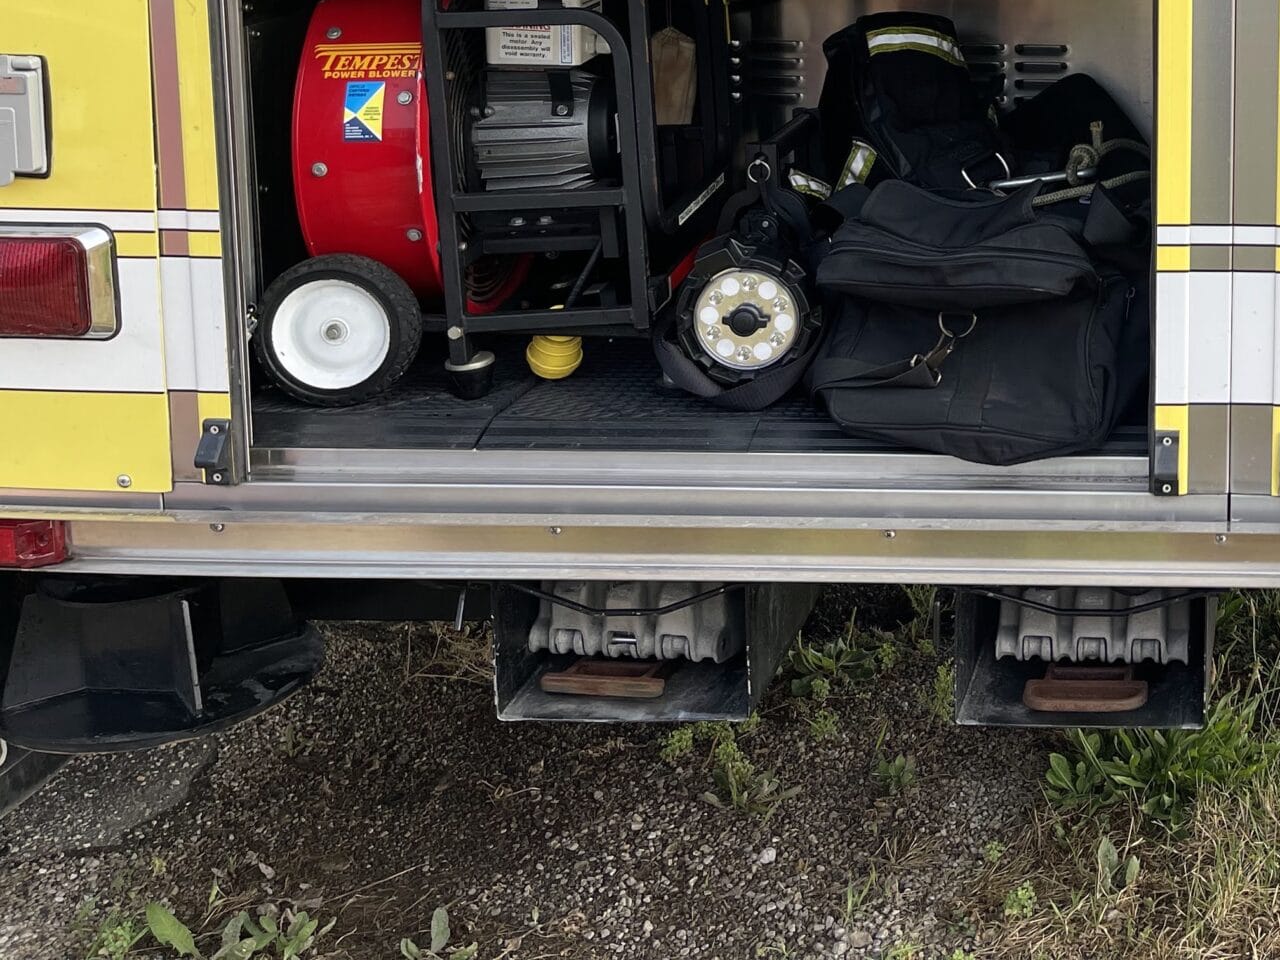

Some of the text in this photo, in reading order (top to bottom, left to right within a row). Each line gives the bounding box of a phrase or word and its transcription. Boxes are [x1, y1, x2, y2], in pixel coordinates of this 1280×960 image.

[501, 44, 539, 52] disassembly
[323, 70, 416, 79] POWER BLOWER
